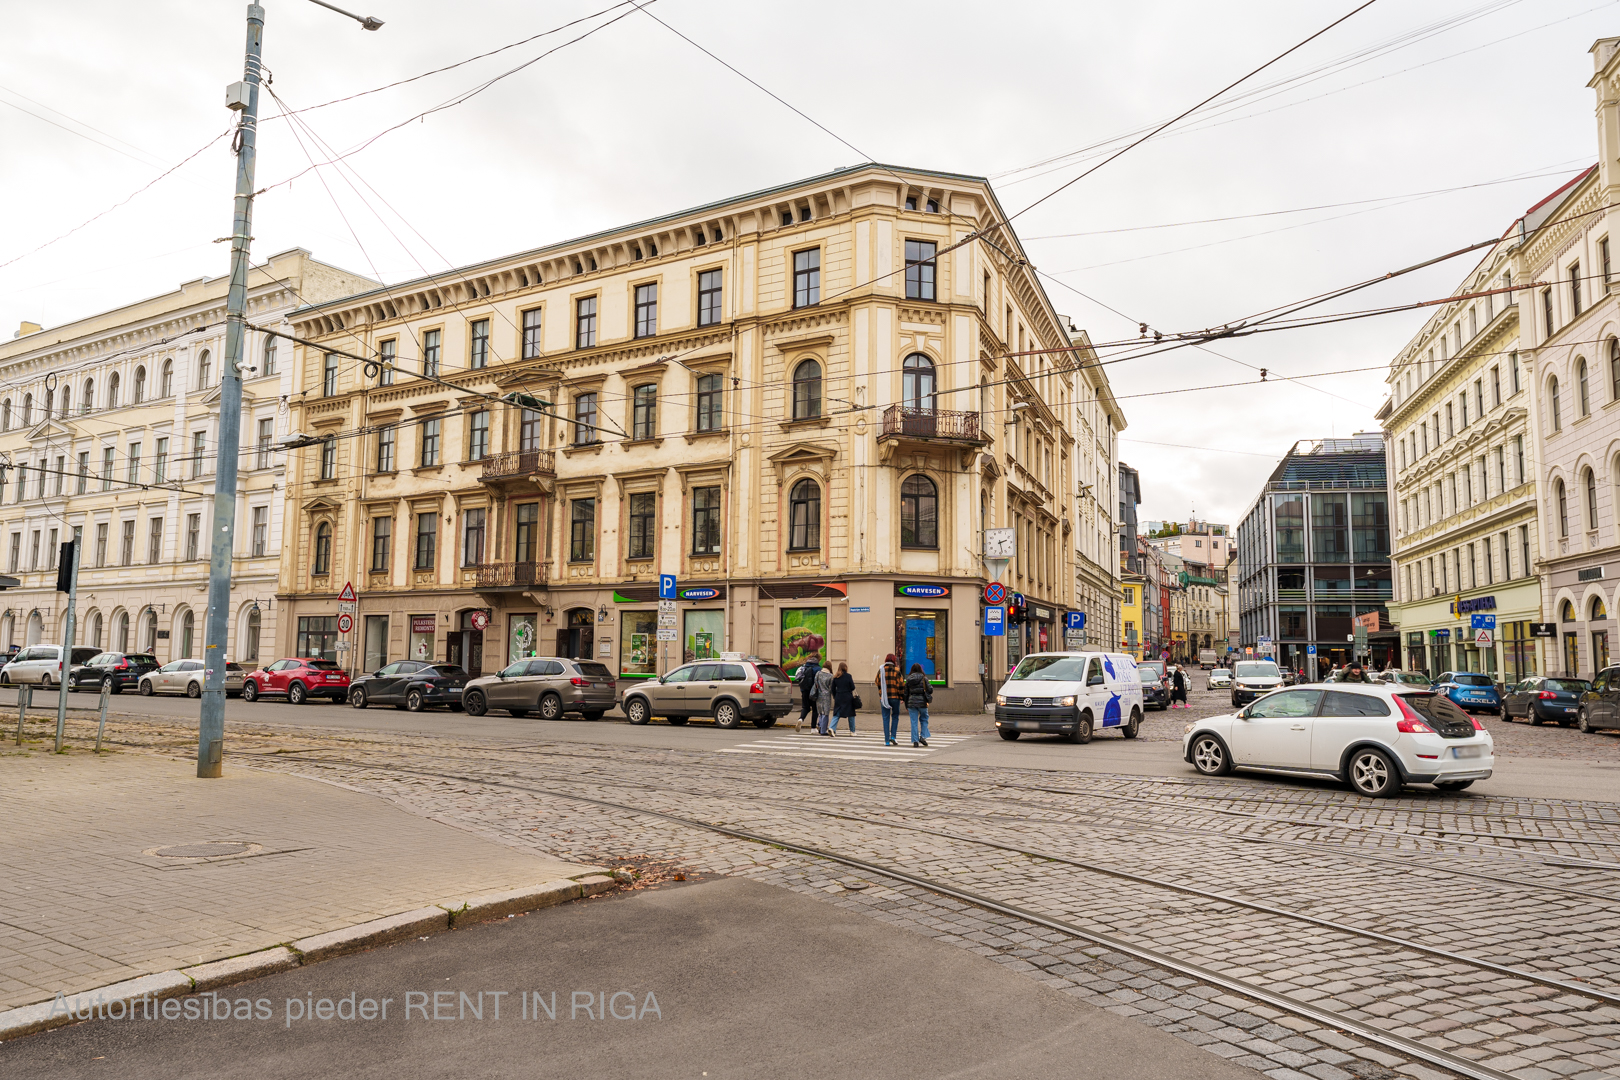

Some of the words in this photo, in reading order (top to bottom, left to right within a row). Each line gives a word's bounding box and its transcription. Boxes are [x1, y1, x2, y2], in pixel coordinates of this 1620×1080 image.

[663, 577, 673, 596] P
[906, 587, 942, 595] NARVESEN
[341, 619, 349, 629] 30
[1071, 613, 1081, 627] P
[1347, 634, 1354, 642] B
[1308, 646, 1315, 655] P
[1459, 697, 1497, 705] ALEXELA
